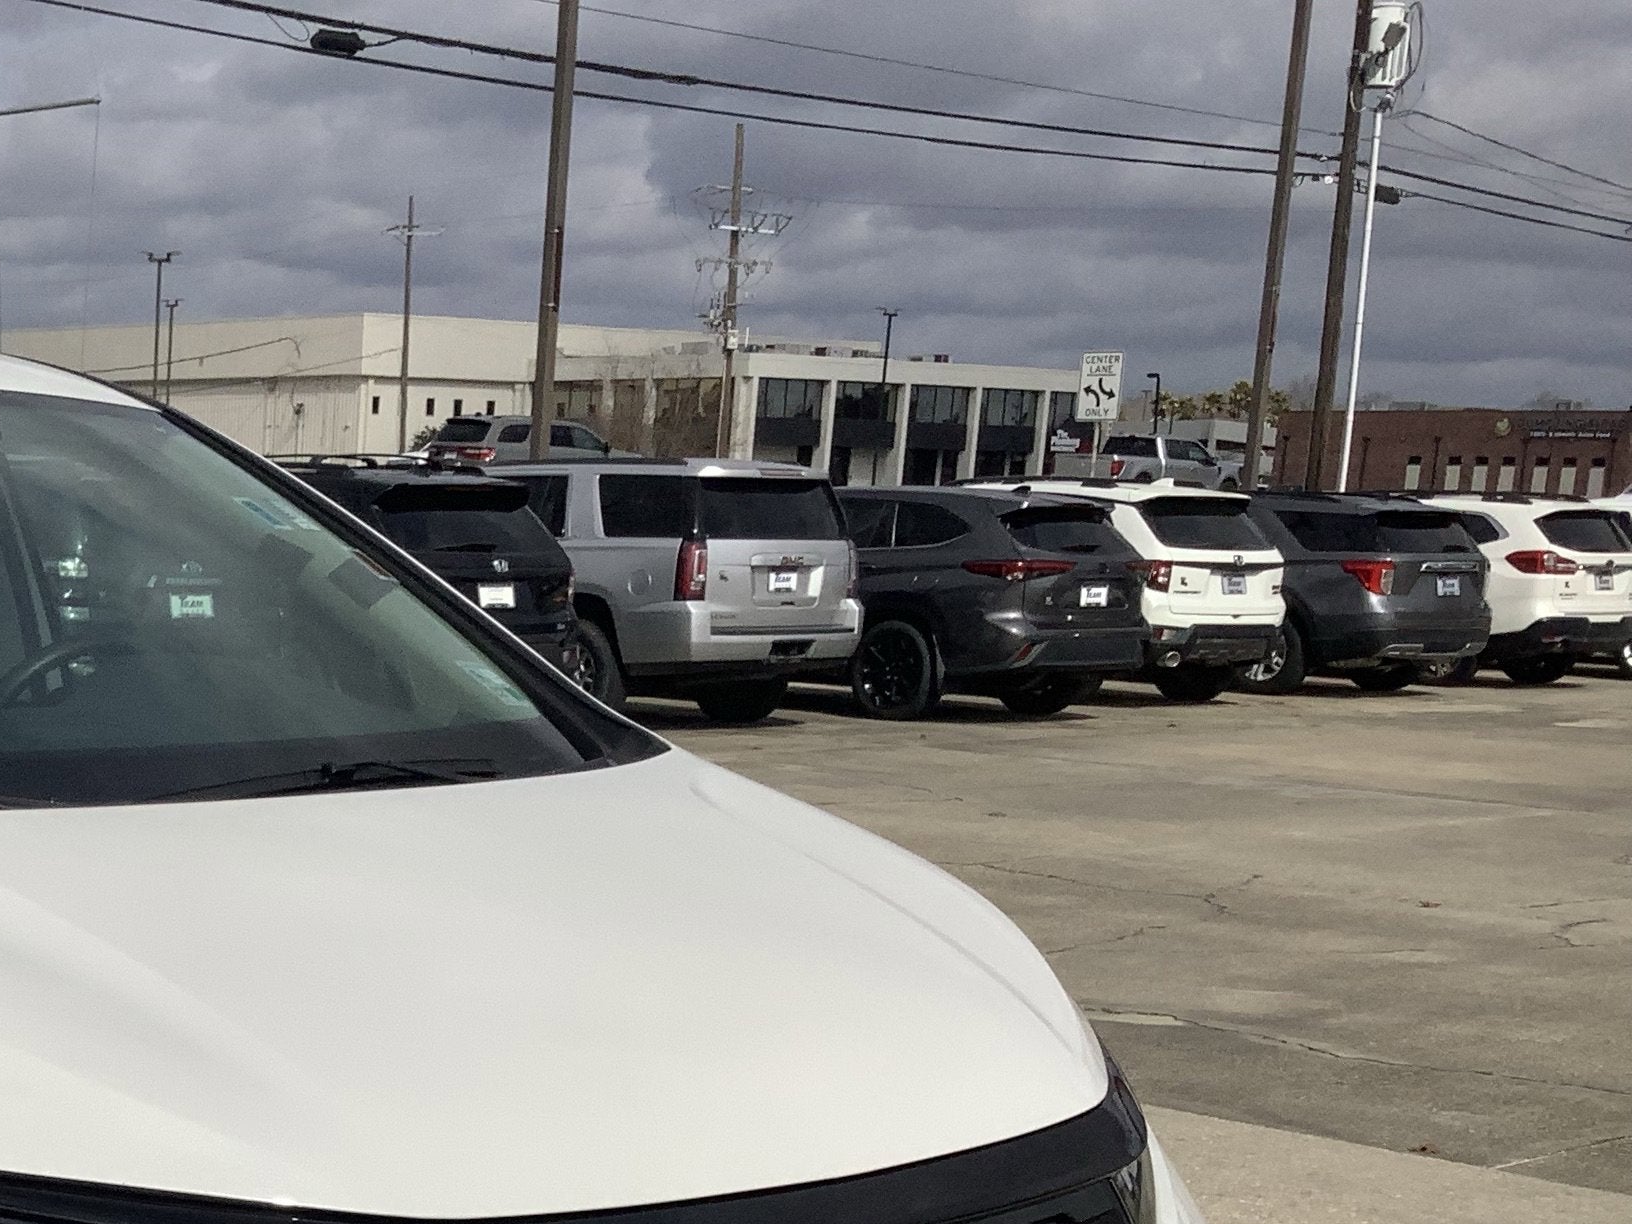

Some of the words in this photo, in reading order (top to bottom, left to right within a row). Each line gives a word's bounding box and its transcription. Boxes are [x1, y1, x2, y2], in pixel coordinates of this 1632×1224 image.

[1085, 355, 1120, 364] CENTER
[1089, 364, 1113, 374] LANE
[1085, 408, 1109, 417] ONLY
